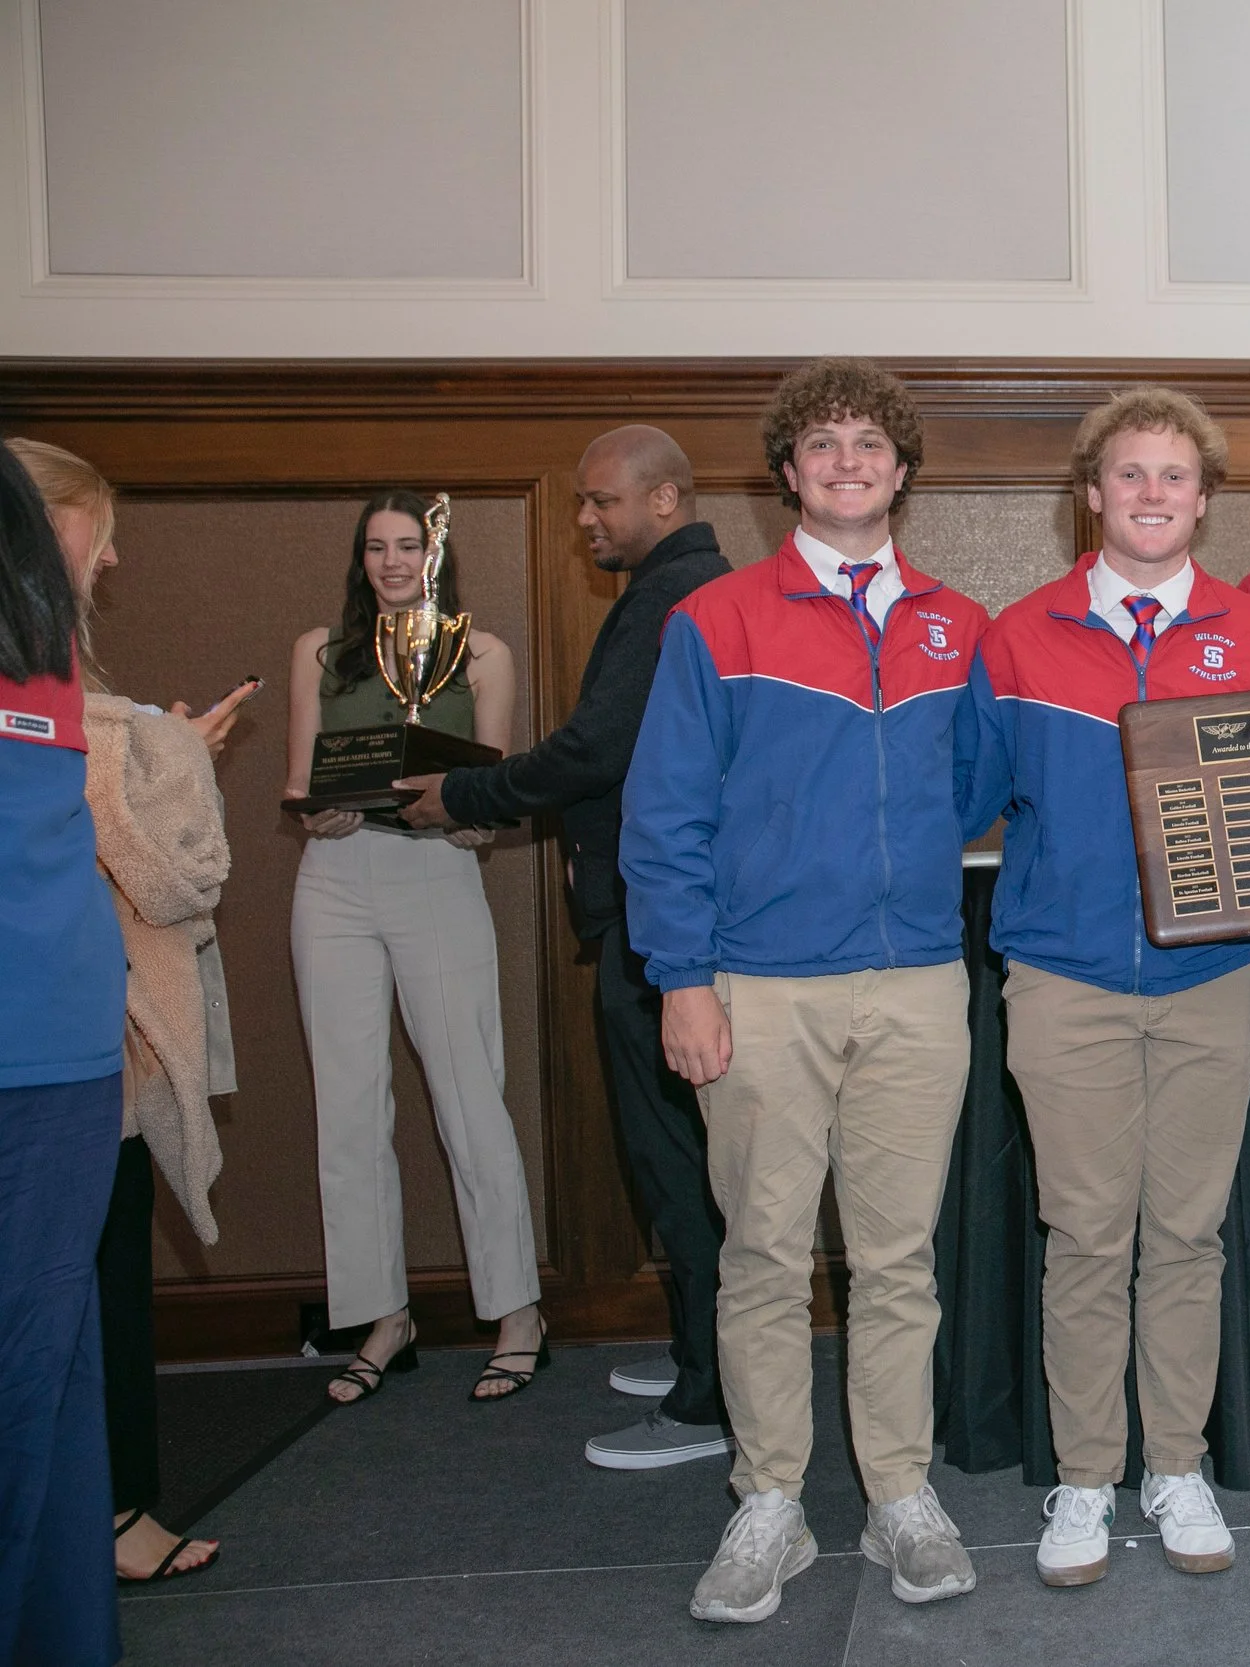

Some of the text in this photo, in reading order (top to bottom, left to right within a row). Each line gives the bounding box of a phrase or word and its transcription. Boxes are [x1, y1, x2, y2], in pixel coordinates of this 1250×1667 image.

[1194, 632, 1236, 648] WILDCAT
[919, 643, 960, 660] ATHLETICS
[1189, 665, 1237, 681] ATHLETICS
[1212, 743, 1239, 754] Awarded
